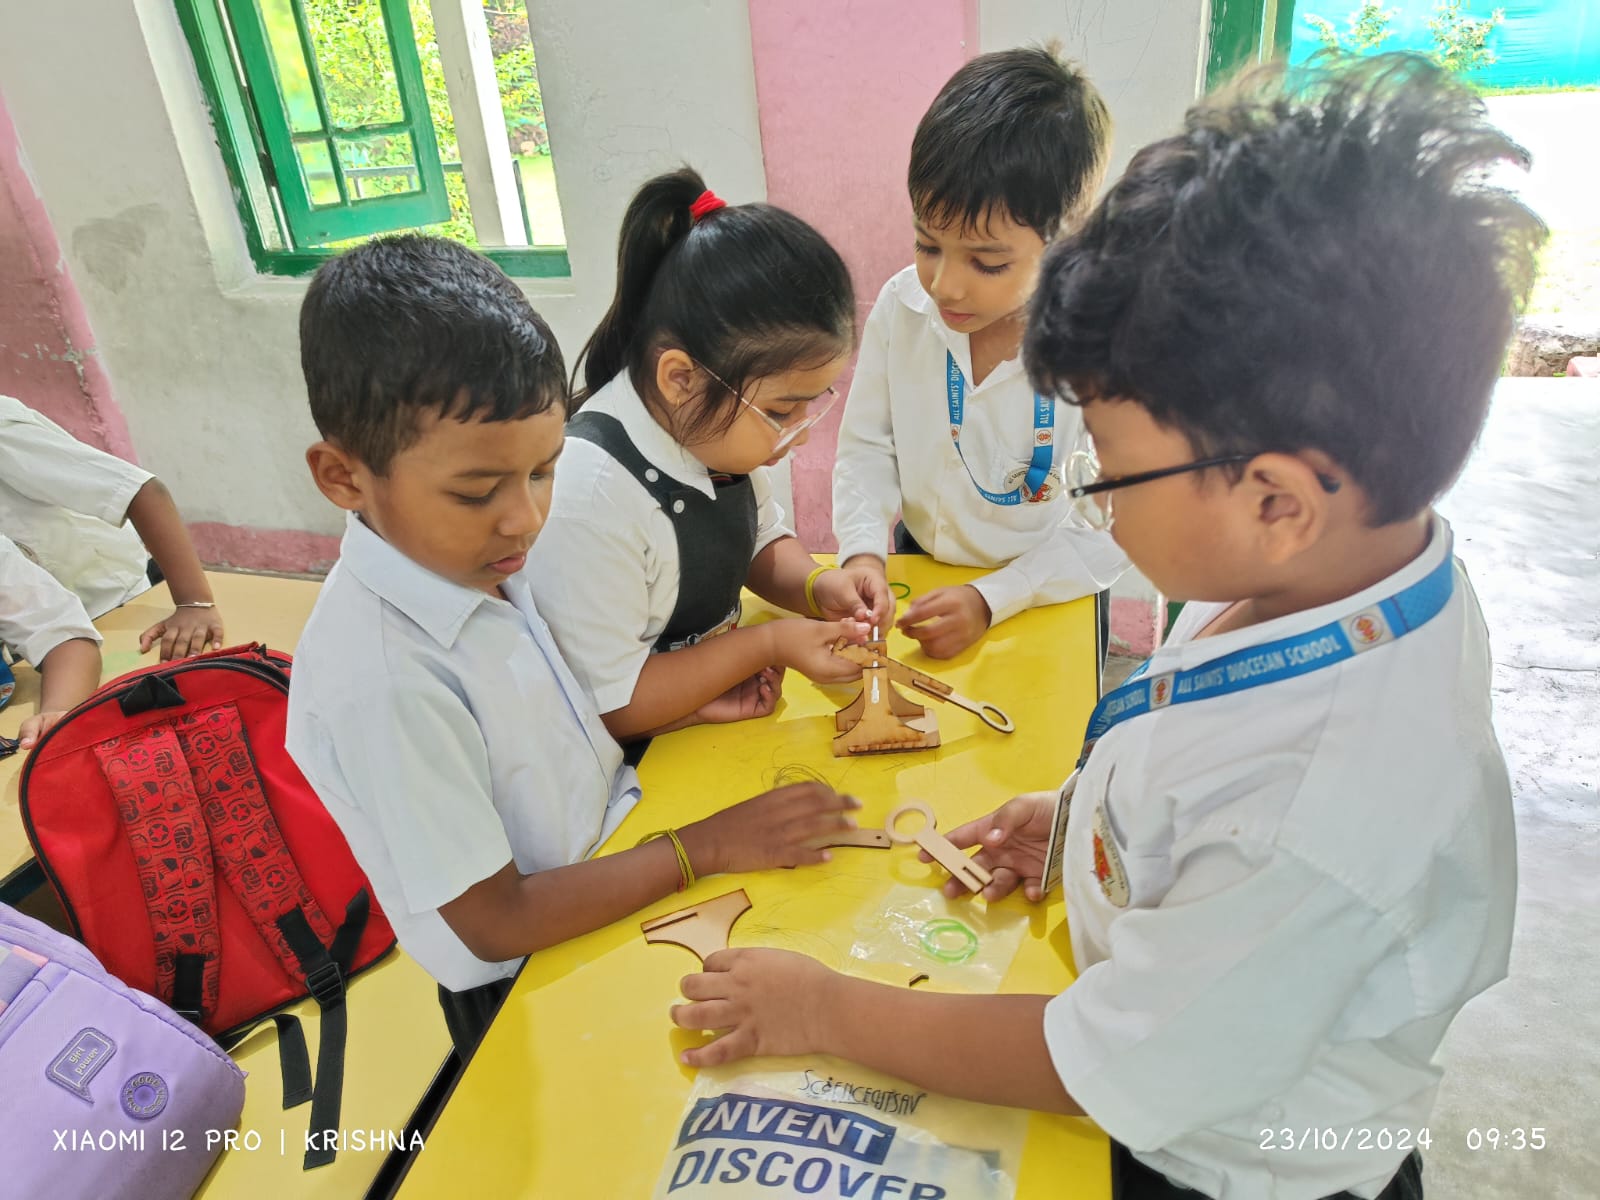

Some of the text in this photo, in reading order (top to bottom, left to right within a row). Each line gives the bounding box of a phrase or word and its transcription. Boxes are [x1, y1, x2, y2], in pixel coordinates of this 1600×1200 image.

[1039, 413, 1050, 424] ALL
[1176, 678, 1193, 696] ALL
[1226, 651, 1286, 683] DIOCESAN
[1285, 634, 1342, 667] SCHOOL
[69, 1046, 86, 1065] girl
[75, 1047, 99, 1076] power
[687, 1100, 886, 1155] INVENT
